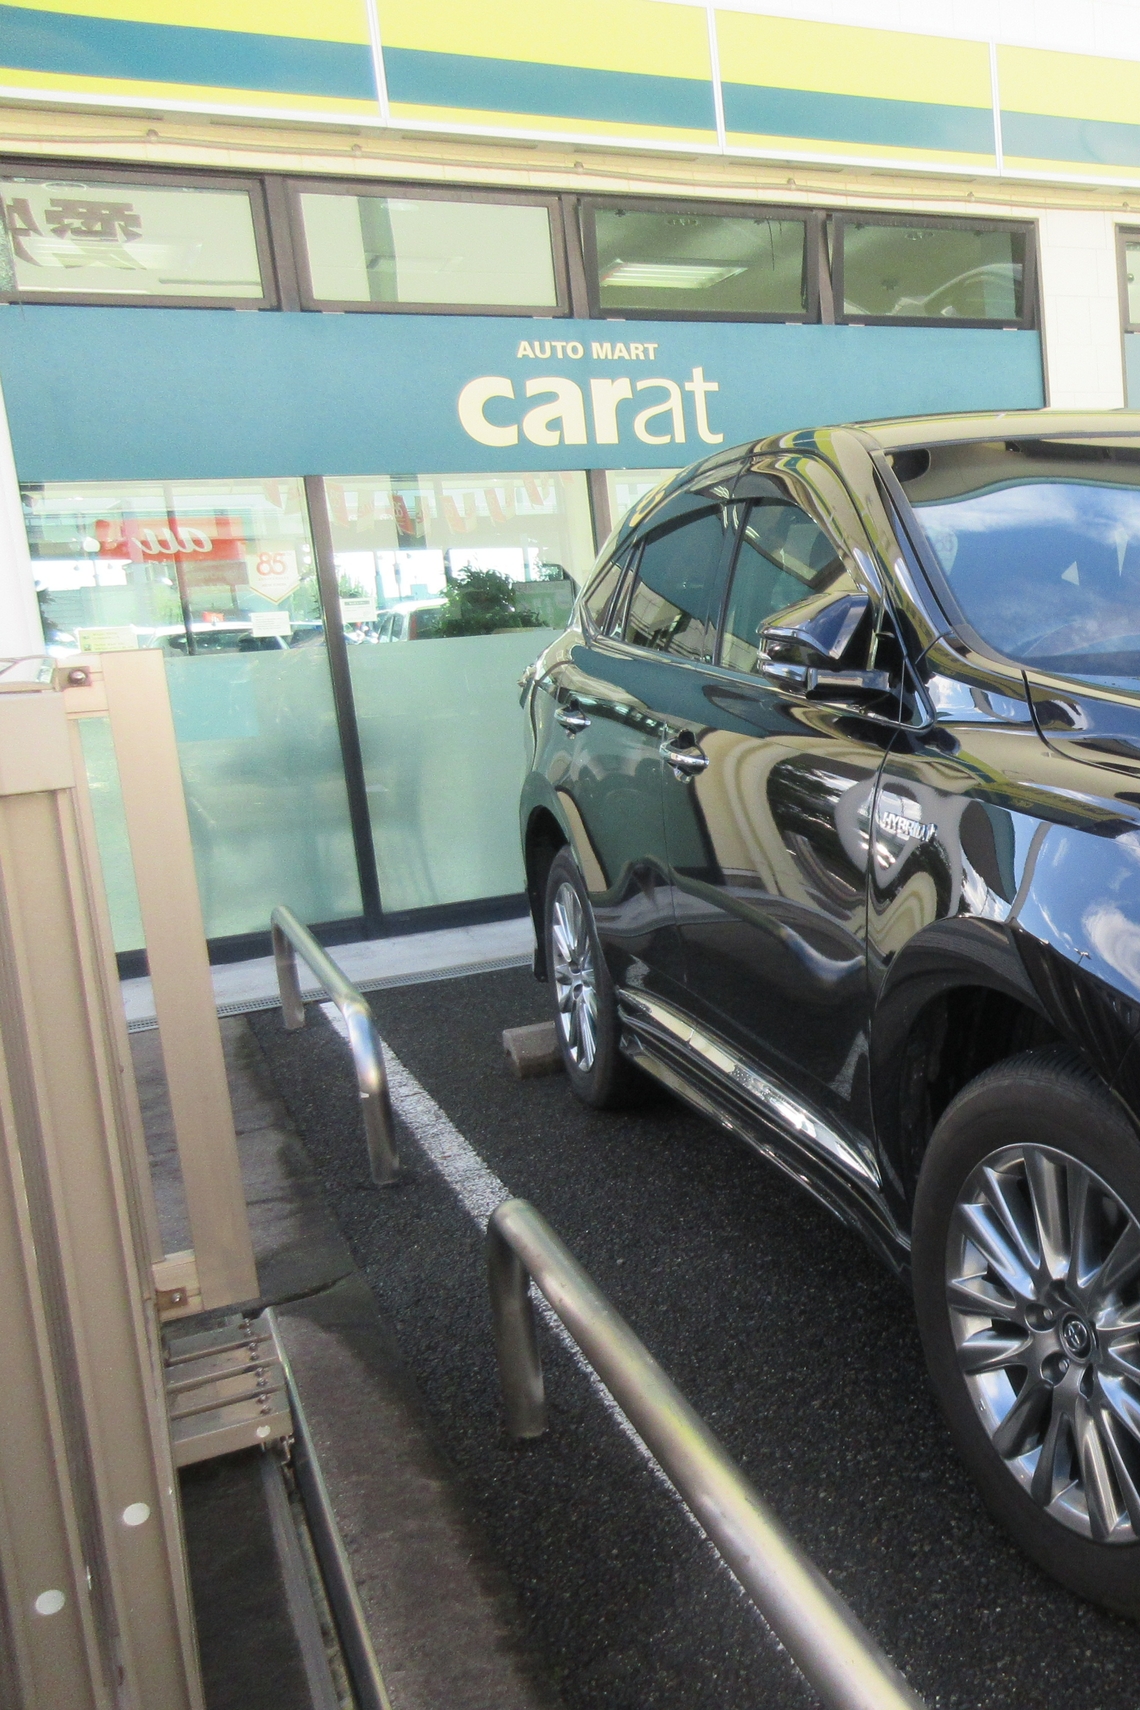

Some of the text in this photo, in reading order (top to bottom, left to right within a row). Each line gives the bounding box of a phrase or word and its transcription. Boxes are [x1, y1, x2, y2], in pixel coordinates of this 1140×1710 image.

[517, 340, 659, 361] AUTO MART
[457, 366, 725, 448] carat
[255, 551, 287, 577] 85
